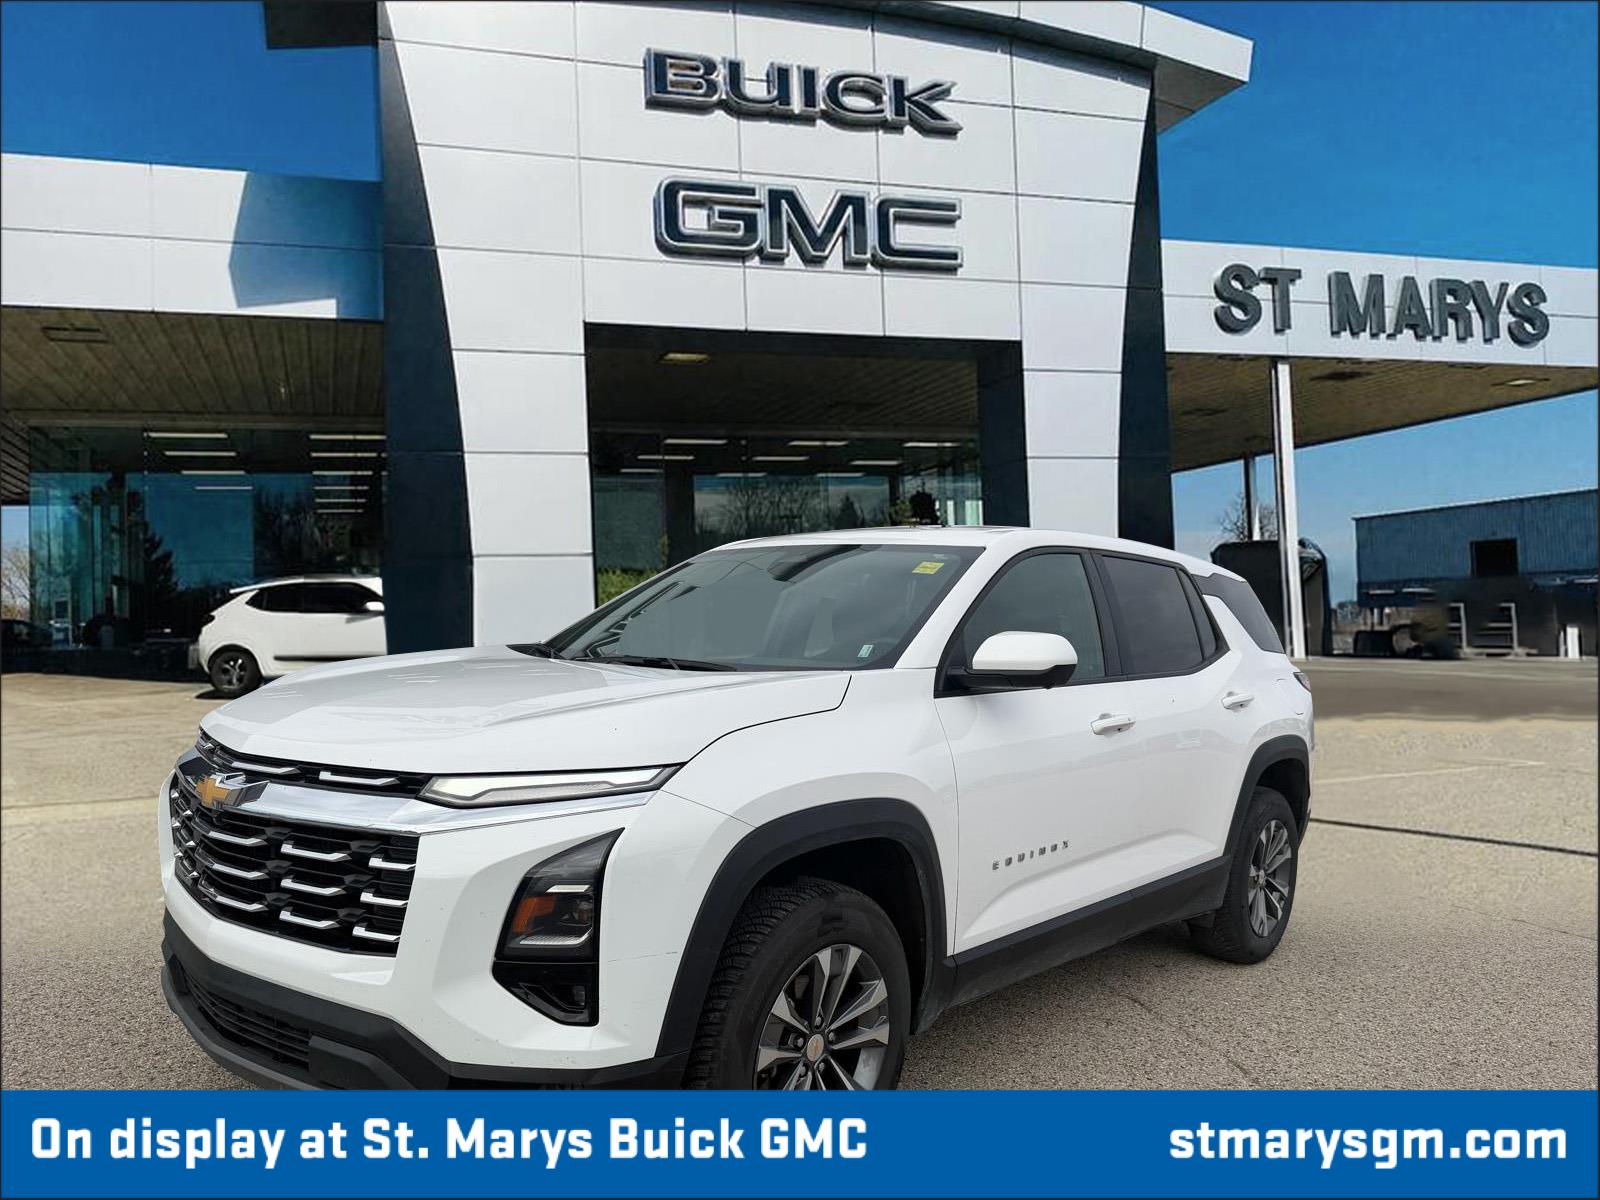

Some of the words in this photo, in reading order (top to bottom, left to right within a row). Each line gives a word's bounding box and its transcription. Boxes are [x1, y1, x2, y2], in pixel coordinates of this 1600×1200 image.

[643, 47, 963, 138] BUICK
[653, 175, 964, 272] GMC
[1213, 263, 1302, 334] ST
[1327, 270, 1550, 347] MARYS
[991, 839, 1070, 871] EQUINOX
